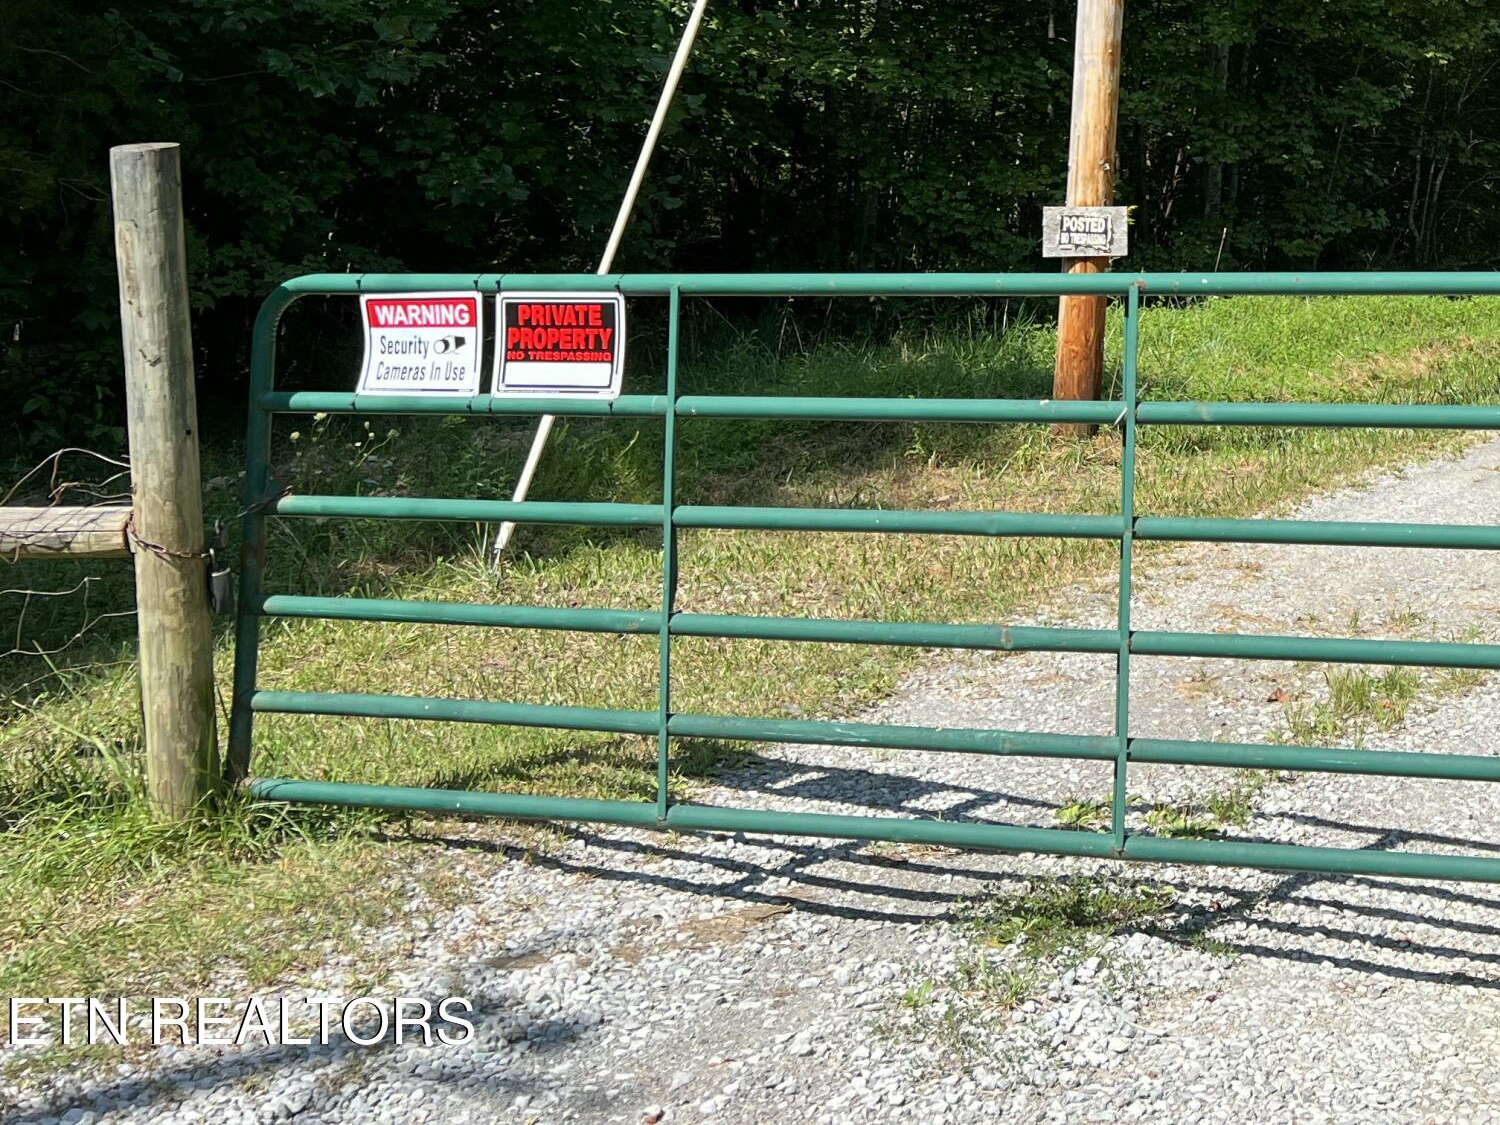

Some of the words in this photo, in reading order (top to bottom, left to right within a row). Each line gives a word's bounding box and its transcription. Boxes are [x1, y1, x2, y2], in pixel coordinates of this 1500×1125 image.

[1062, 216, 1106, 233] POSTED
[374, 303, 470, 325] WARNING
[517, 304, 602, 326] PRIVATE
[380, 335, 429, 358] Security
[507, 327, 613, 350] PROPERTY
[507, 351, 526, 361] NO
[528, 351, 612, 362] TRESPASSING
[376, 362, 426, 381] Cameras
[430, 362, 442, 381] In
[445, 362, 466, 381] Use
